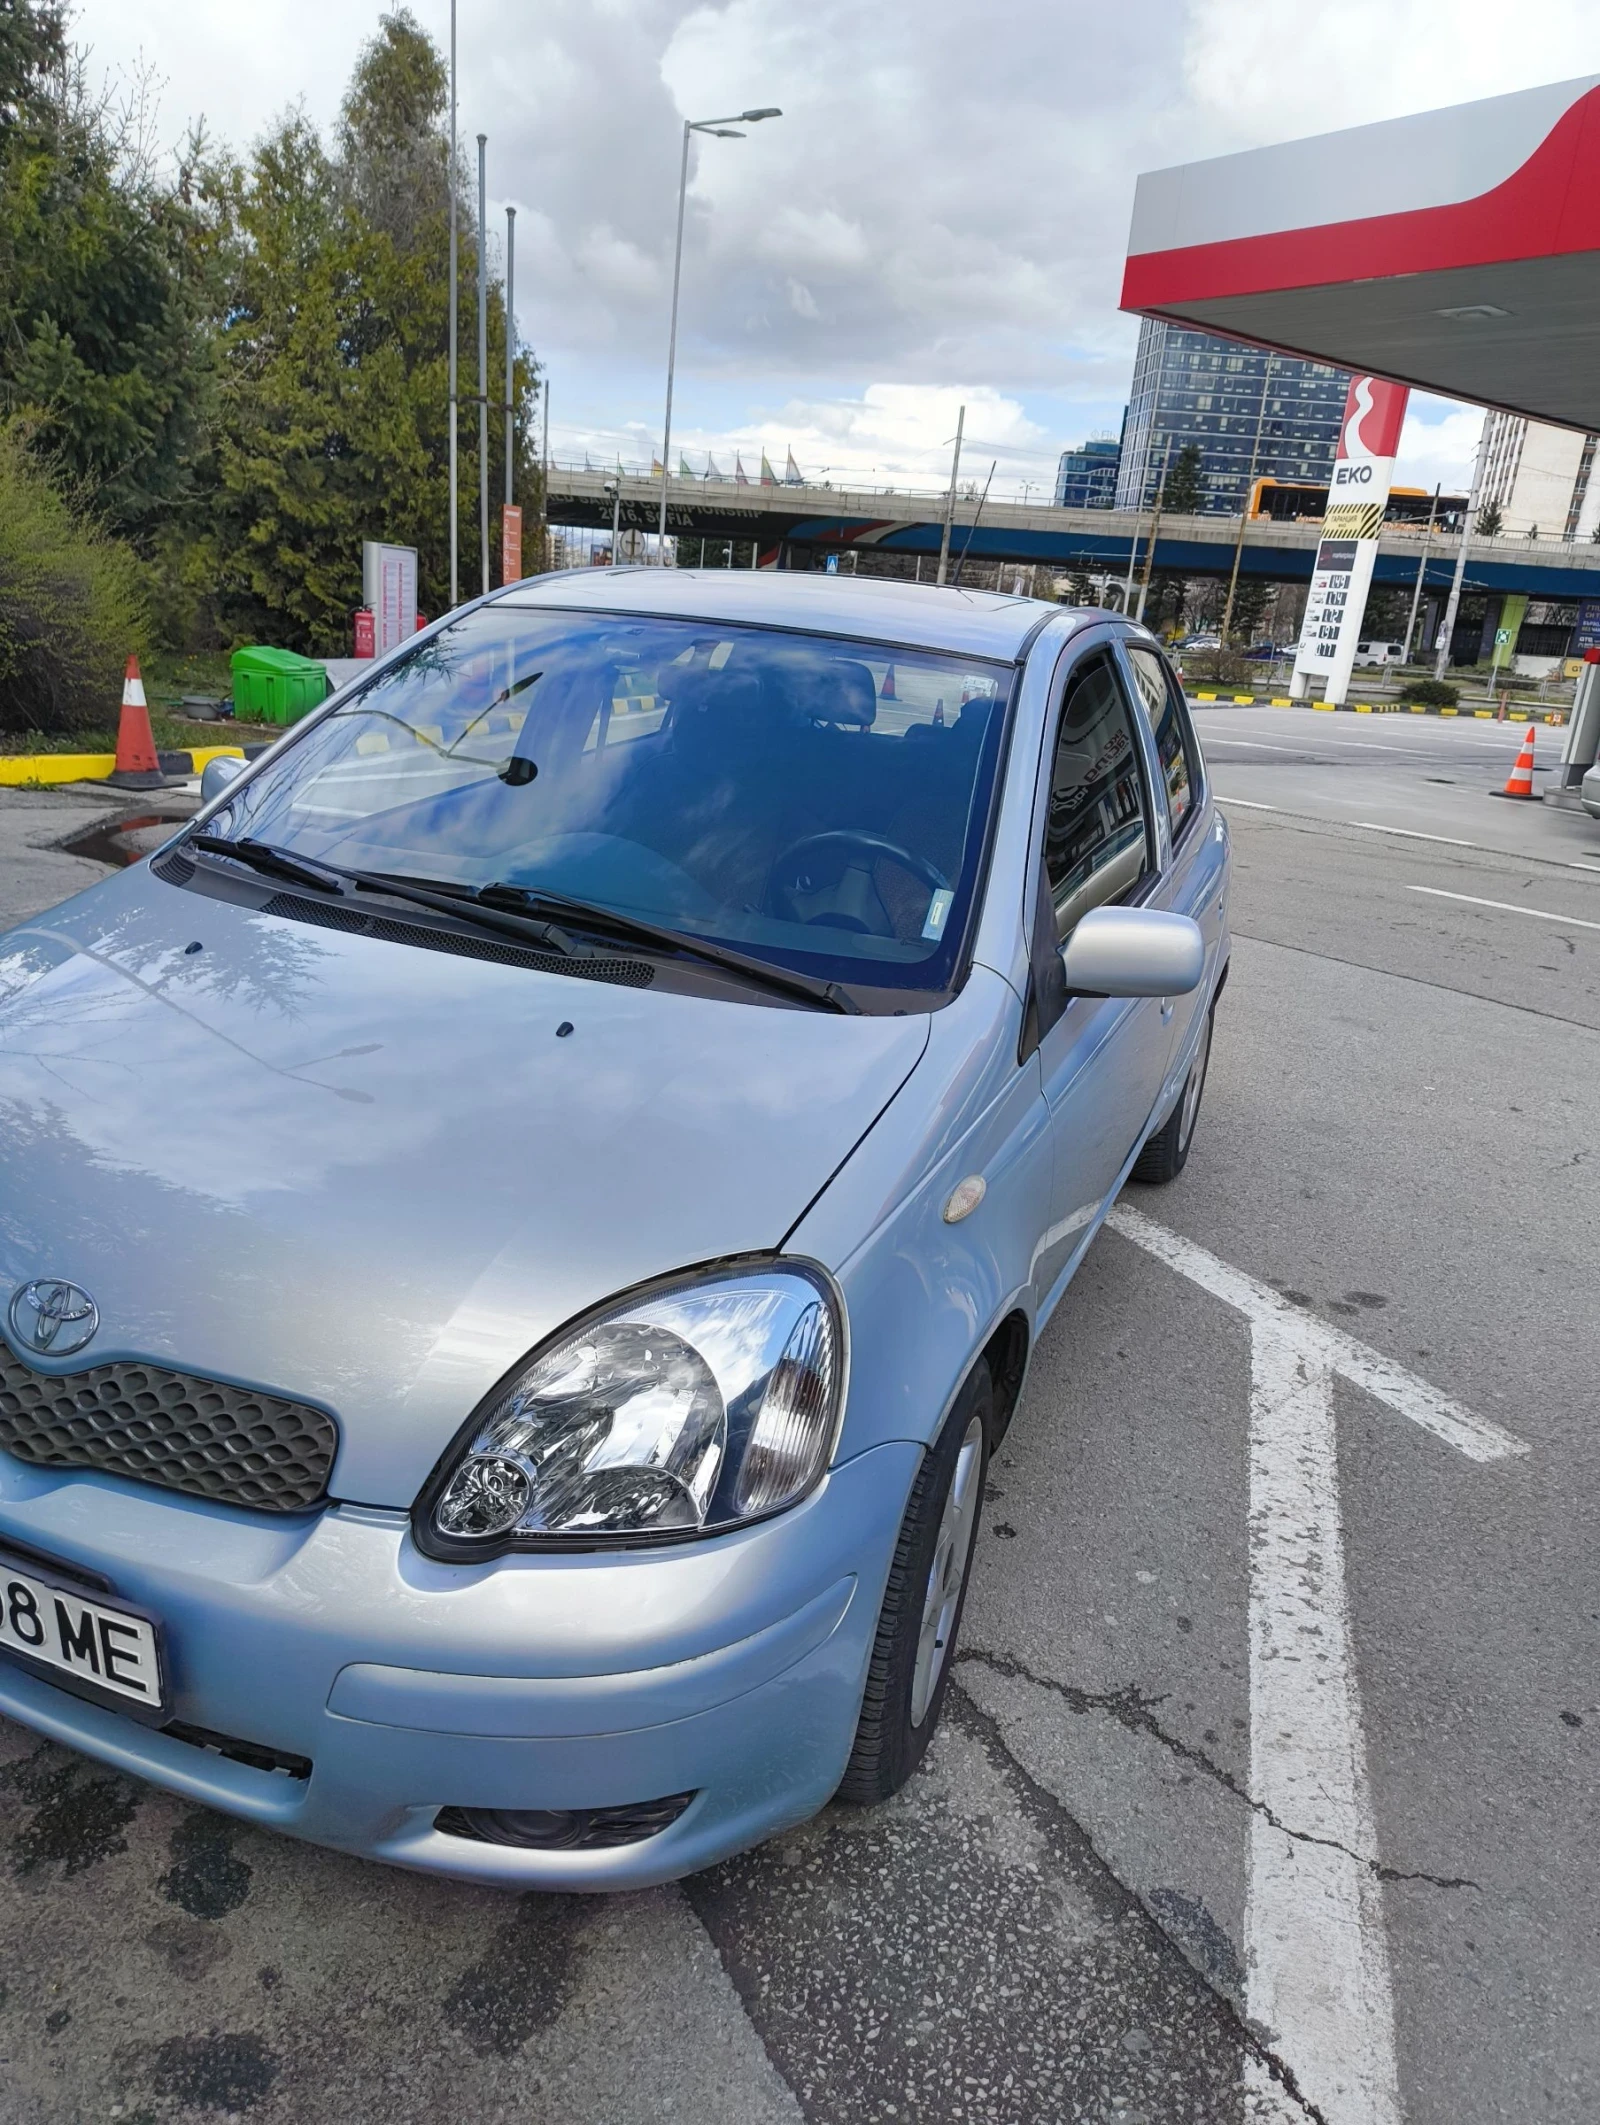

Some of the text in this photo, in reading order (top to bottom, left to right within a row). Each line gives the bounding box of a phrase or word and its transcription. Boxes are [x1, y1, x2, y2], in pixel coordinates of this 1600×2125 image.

[1336, 465, 1372, 484] EKO
[580, 496, 634, 508] SAMO
[0, 1580, 148, 1692] 8 ME
